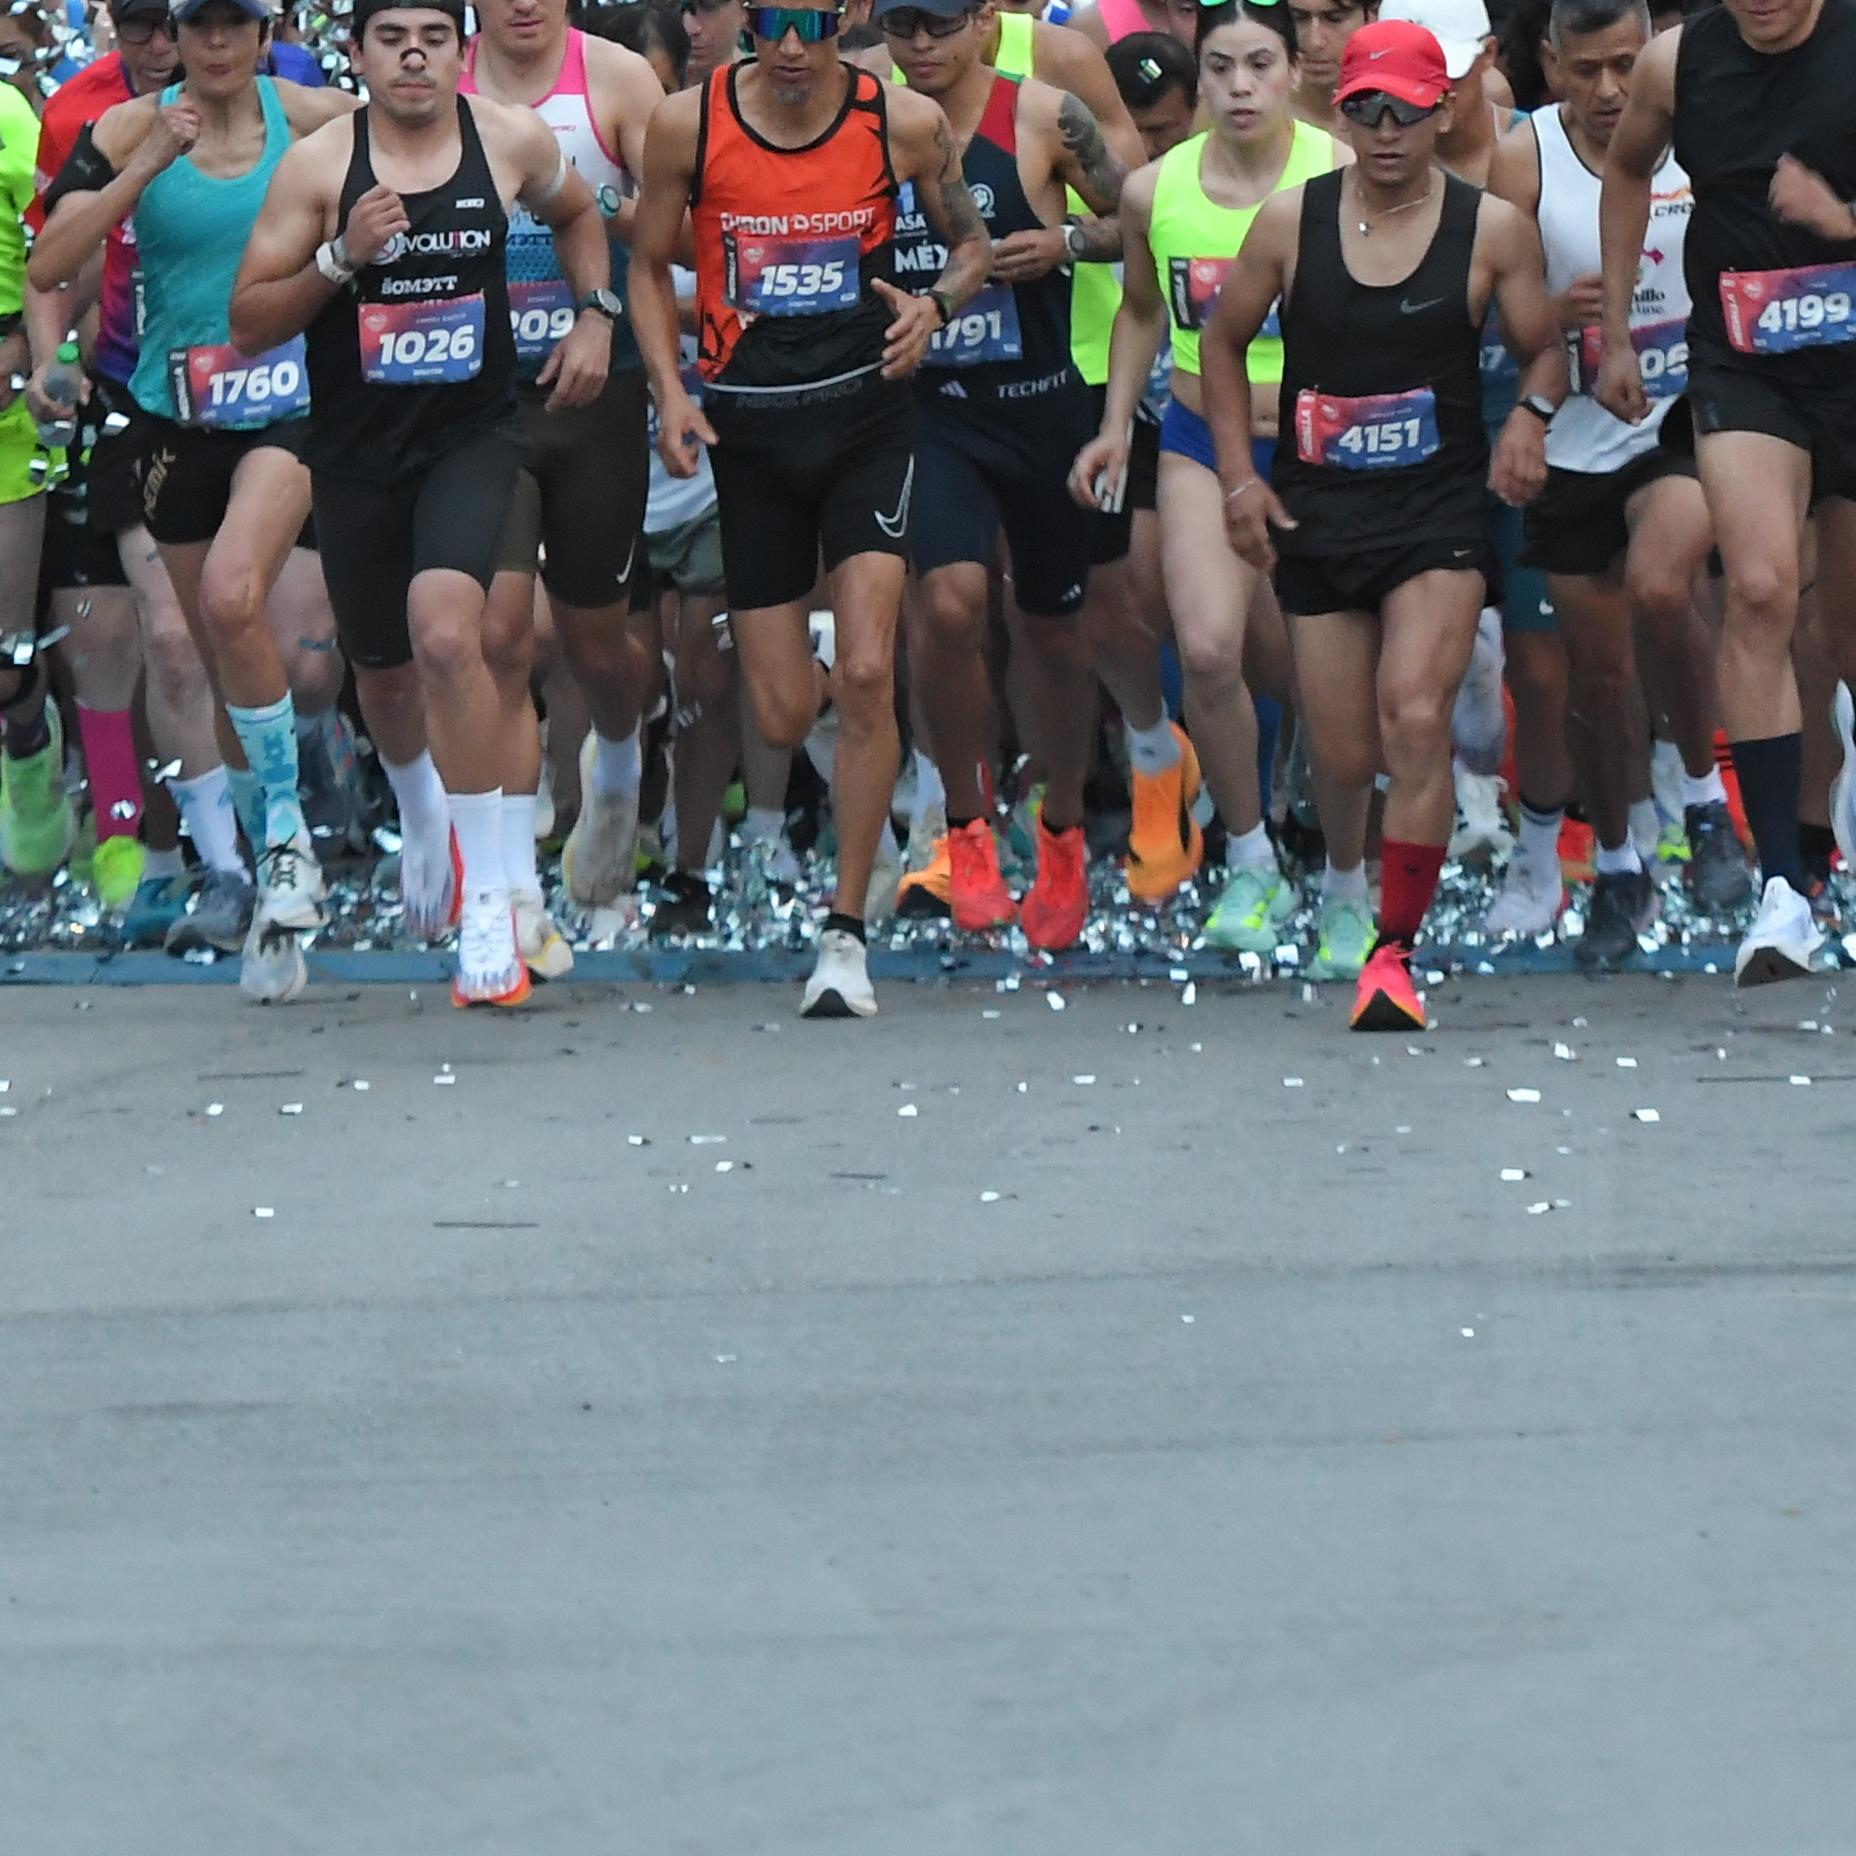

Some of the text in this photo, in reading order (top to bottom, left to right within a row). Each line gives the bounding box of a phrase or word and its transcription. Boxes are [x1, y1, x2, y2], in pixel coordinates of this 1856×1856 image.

[810, 206, 875, 233] SPORT
[760, 260, 844, 297] 1535
[1757, 292, 1851, 334] 4199
[379, 324, 475, 366] 1026
[208, 359, 301, 406] 1760
[998, 367, 1068, 399] TECHFIT
[1337, 417, 1421, 454] 4151
